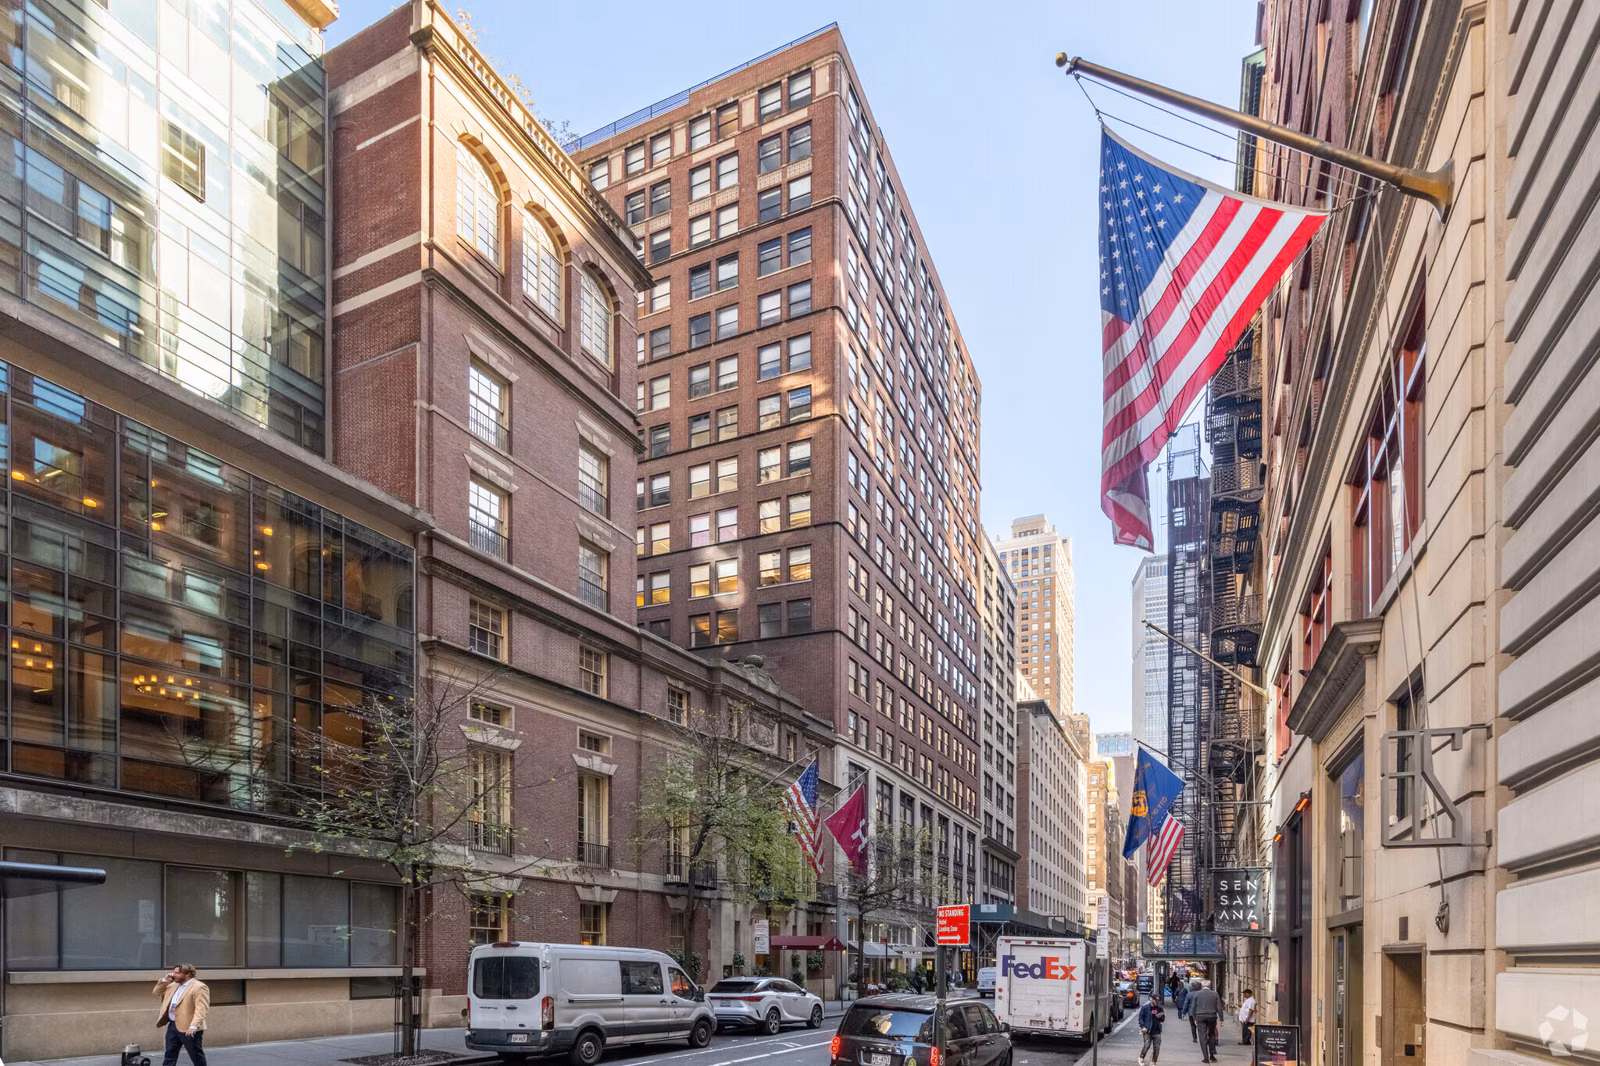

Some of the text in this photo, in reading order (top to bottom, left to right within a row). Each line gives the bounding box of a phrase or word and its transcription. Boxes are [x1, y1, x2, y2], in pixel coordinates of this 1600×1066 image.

[1219, 879, 1257, 891] SEN
[1220, 894, 1257, 906] SAK
[945, 908, 964, 917] STANDING
[1219, 909, 1258, 920] ANA
[1002, 954, 1078, 981] FedEx
